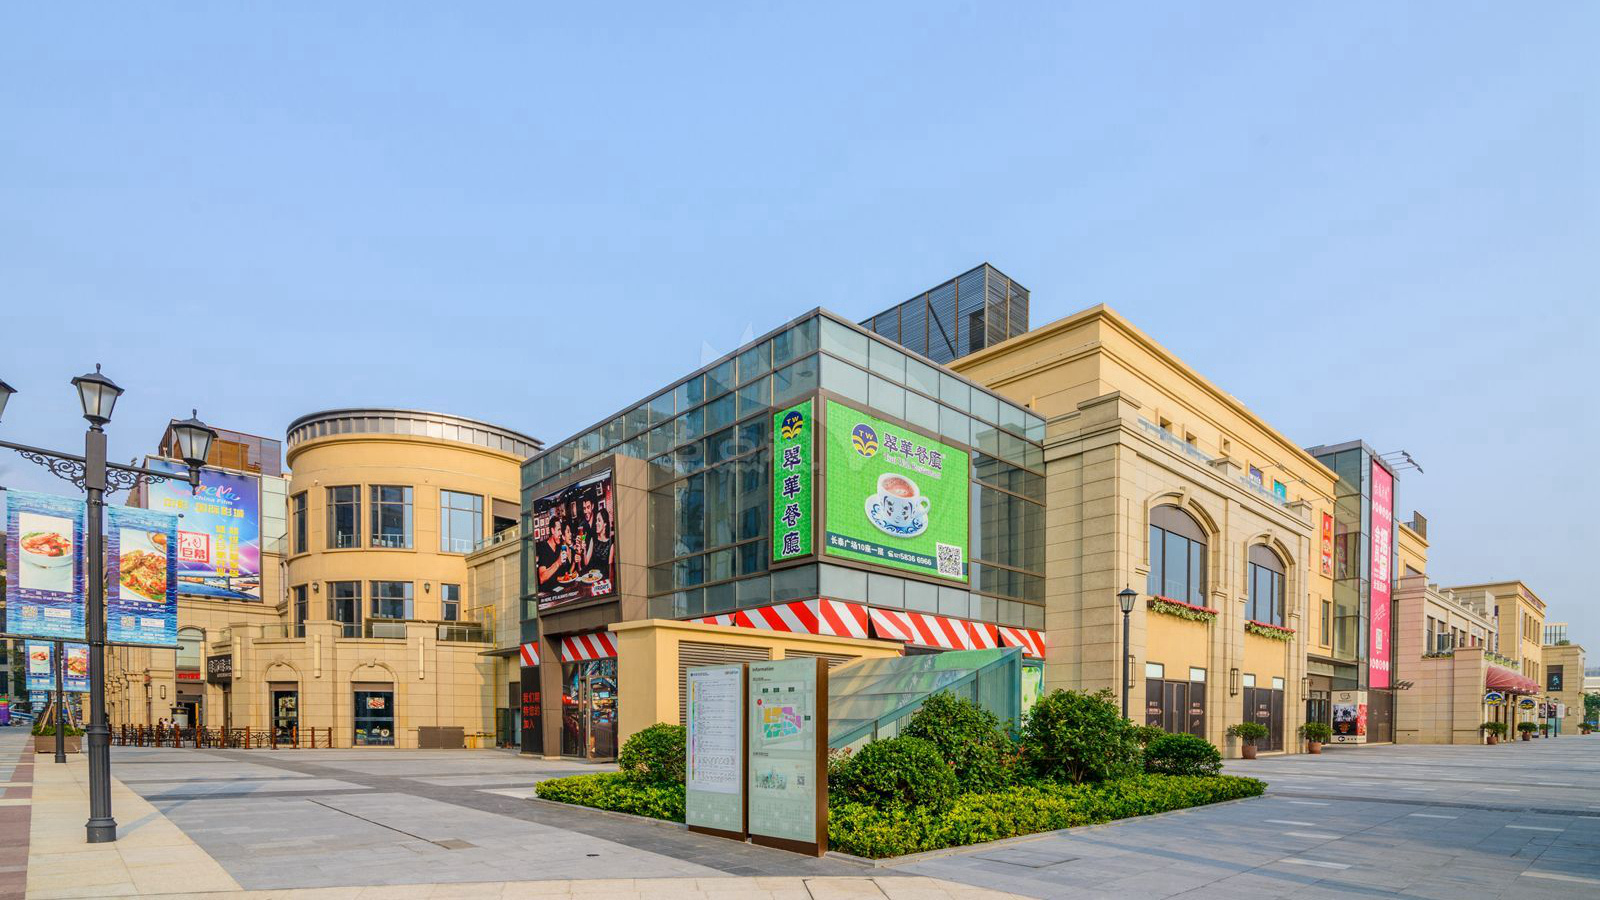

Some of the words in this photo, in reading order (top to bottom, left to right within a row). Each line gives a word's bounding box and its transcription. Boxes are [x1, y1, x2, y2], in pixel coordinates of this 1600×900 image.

[883, 432, 942, 470] 翠華餐廳
[782, 446, 802, 556] 翠華餐廳
